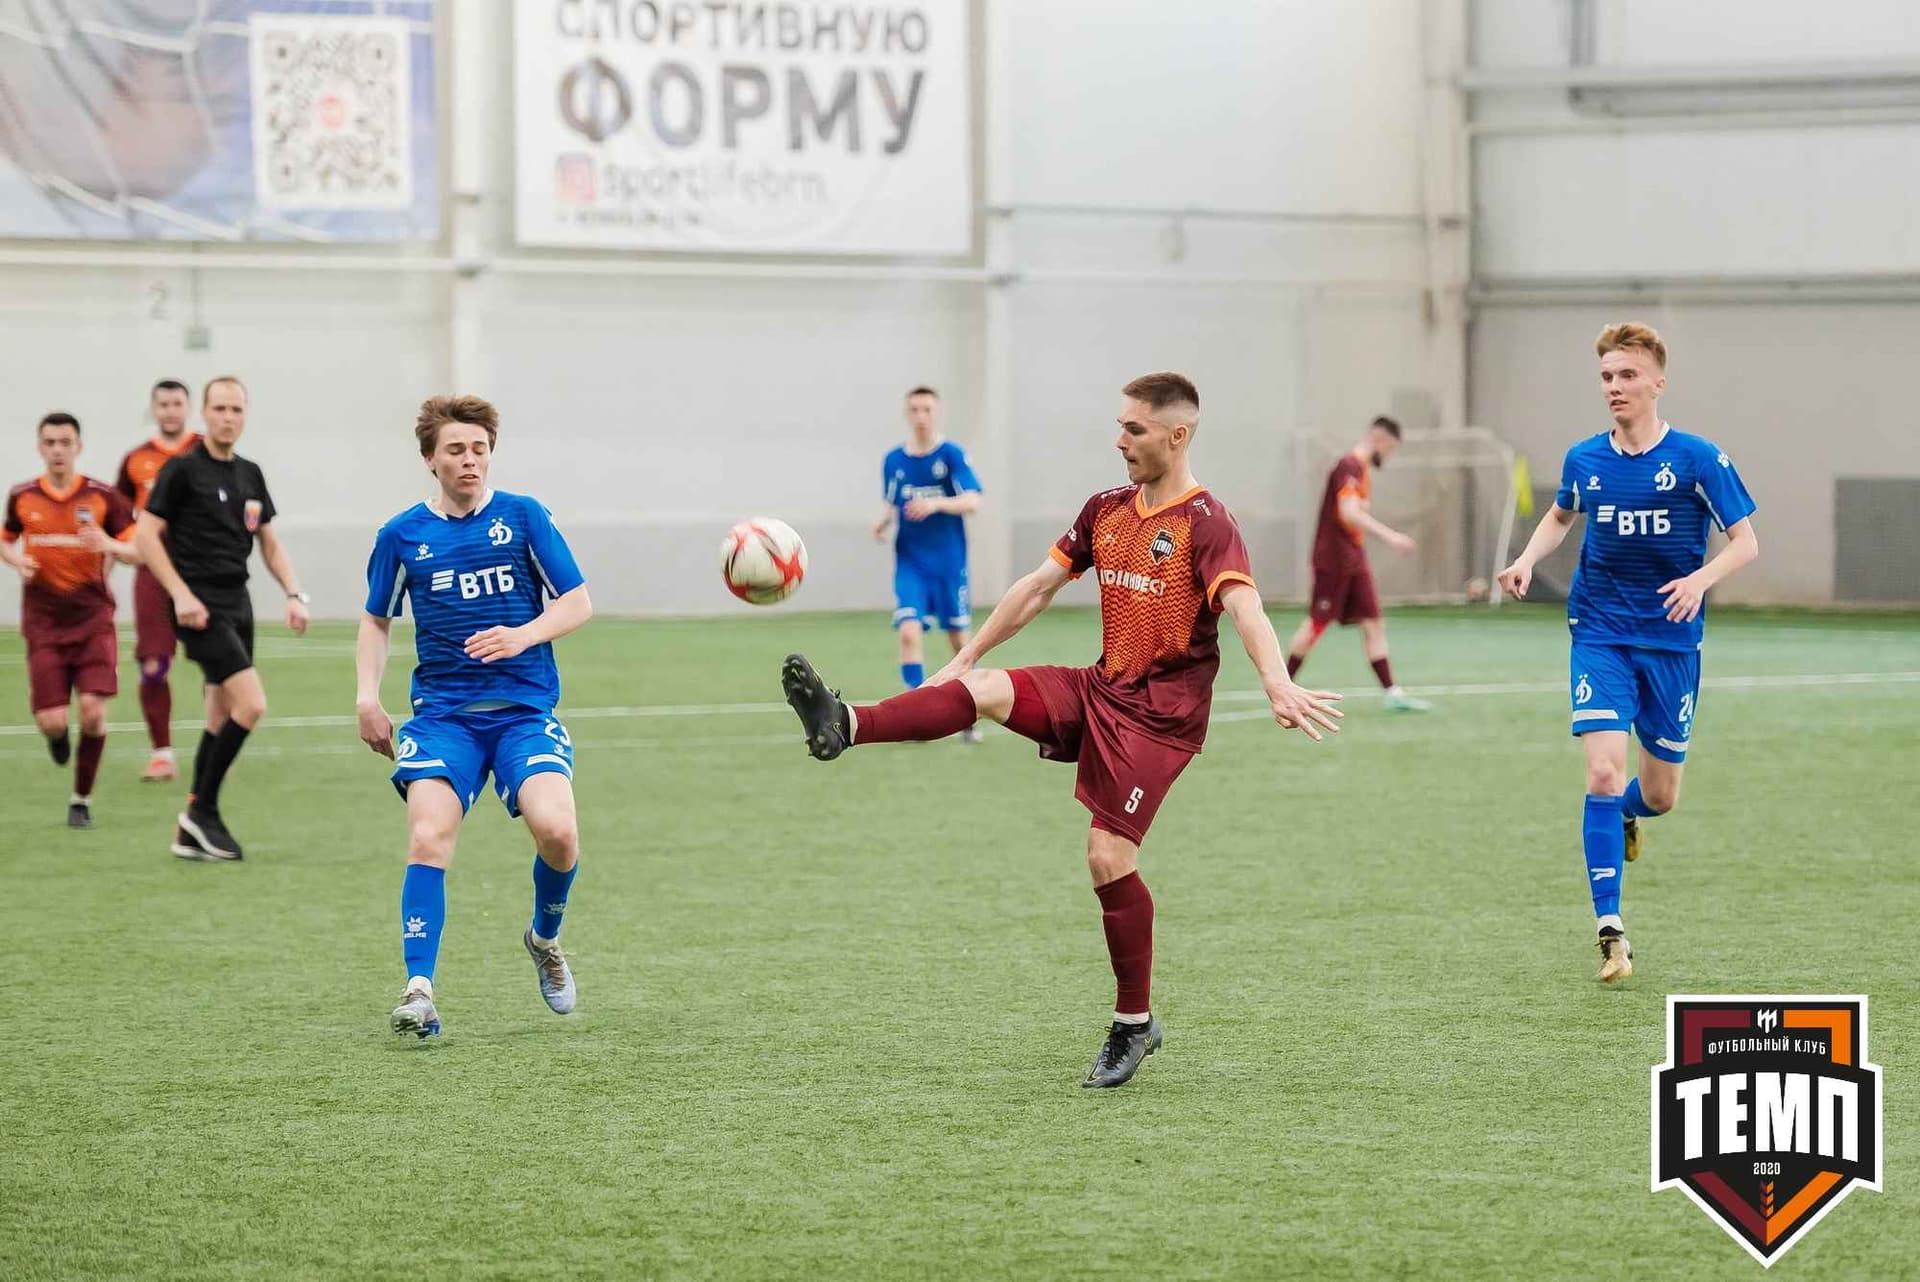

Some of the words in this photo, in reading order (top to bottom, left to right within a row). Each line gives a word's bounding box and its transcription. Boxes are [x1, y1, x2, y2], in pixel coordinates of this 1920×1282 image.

[557, 0, 930, 53] СПОРТИВНУЮ
[558, 57, 925, 155] ФОРМУ
[1618, 509, 1671, 536] ВТБ
[458, 564, 515, 600] ВТБ
[1124, 786, 1144, 814] 5
